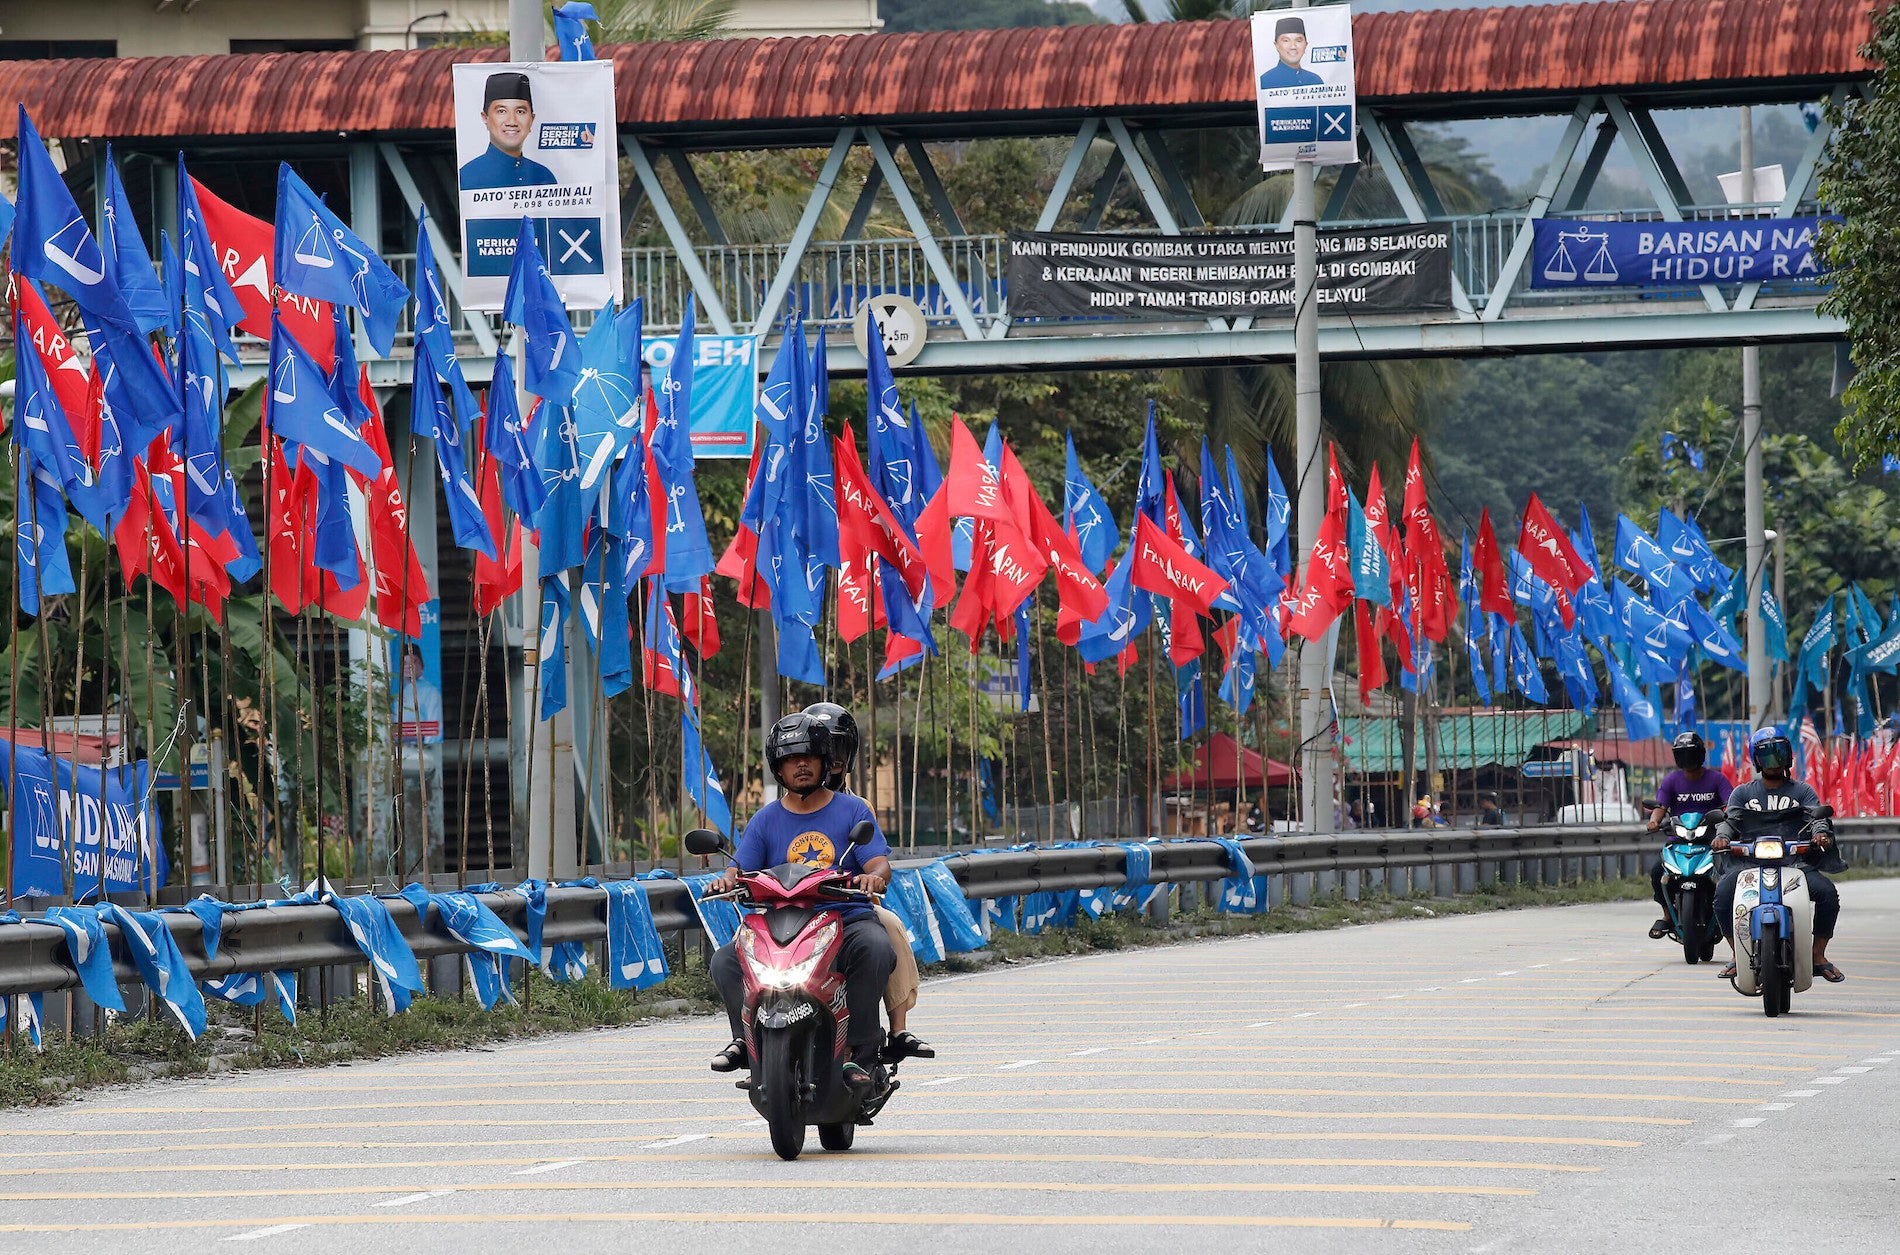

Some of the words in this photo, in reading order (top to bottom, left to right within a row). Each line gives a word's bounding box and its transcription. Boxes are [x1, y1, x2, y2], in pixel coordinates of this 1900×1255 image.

[540, 138, 577, 147] STABIL
[473, 191, 507, 202] DATO'
[508, 189, 532, 200] SERI
[534, 187, 571, 199] AZMIN
[573, 186, 592, 196] ALI
[513, 201, 542, 209] P.098
[547, 198, 592, 207] GOMBAK
[1011, 241, 1047, 256] KAMI
[1051, 242, 1129, 257] PENDUDUK
[1132, 242, 1195, 257] GOMBAK
[1198, 243, 1246, 256] UTARA
[1249, 237, 1341, 255] MENYONG
[1345, 237, 1366, 252] MB
[1370, 233, 1448, 251] SELANGOR
[1638, 230, 1763, 255] BARISAN
[479, 248, 517, 256] NASIO
[1042, 267, 1052, 281] &
[1057, 267, 1132, 282] KERAJAAN
[1140, 266, 1193, 281] NEGERI
[1196, 265, 1286, 281] MEMBANTAH
[1331, 263, 1345, 278] DI
[1349, 260, 1416, 277] GOMBAK!
[1651, 256, 1755, 280] HIDUP
[1090, 292, 1135, 307] HIDUP
[1138, 292, 1186, 307] TANAH
[1190, 290, 1246, 307] TRADISI
[1316, 287, 1366, 303] ELAYU!
[1690, 792, 1716, 802] YONEX
[791, 835, 828, 852] CONVERSE
